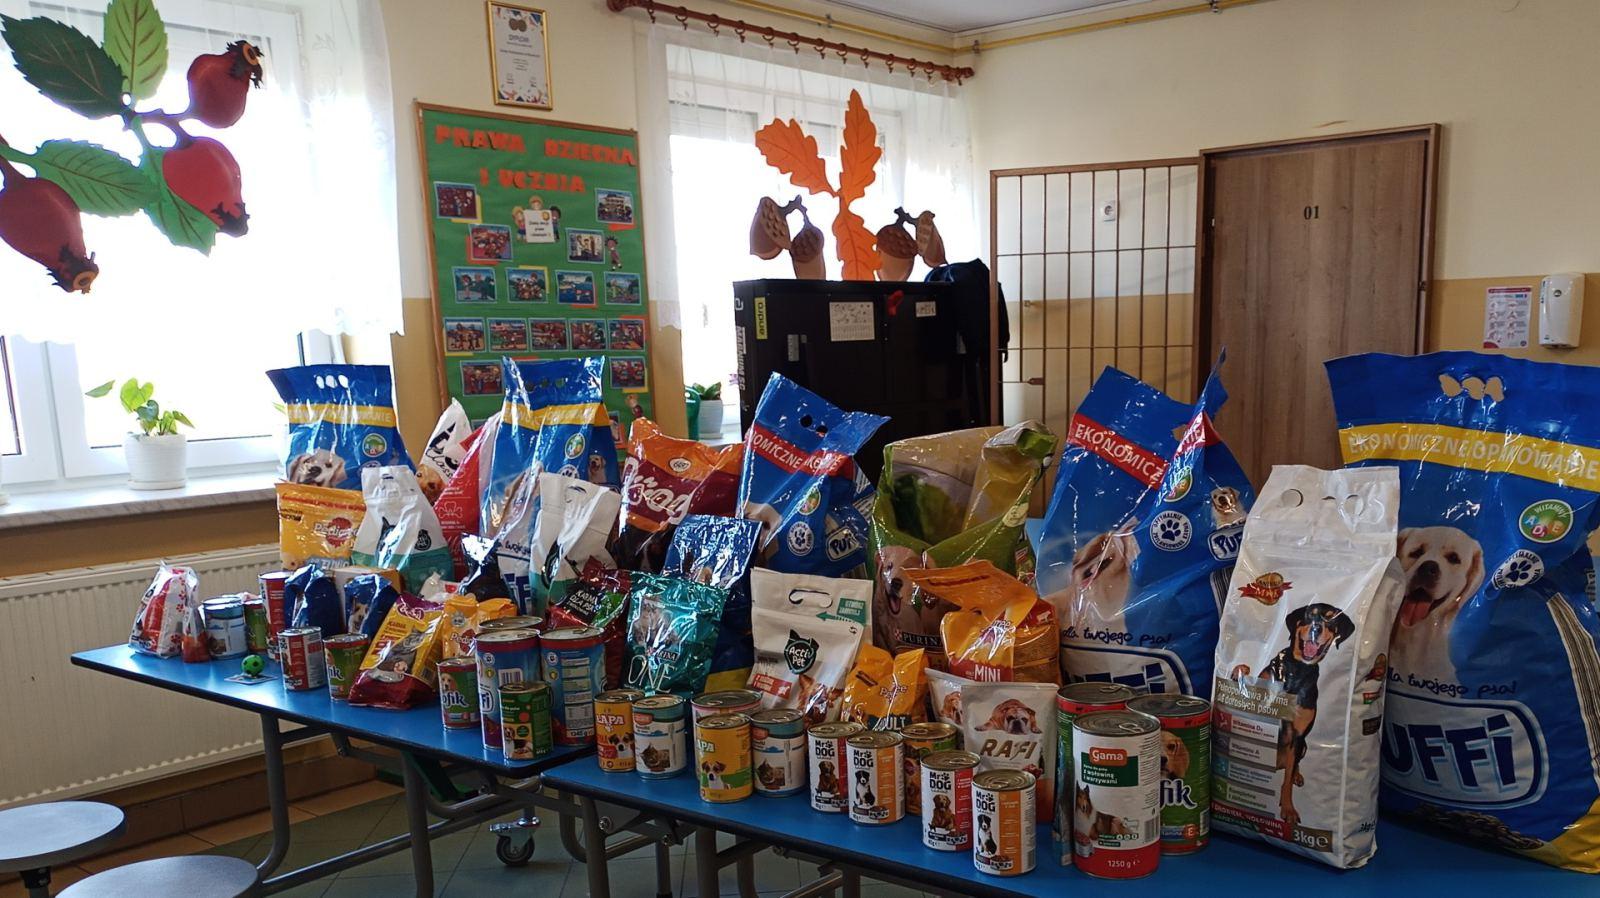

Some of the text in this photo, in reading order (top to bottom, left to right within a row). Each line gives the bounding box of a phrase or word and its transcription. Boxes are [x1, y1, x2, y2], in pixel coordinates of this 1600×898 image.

[435, 125, 637, 166] PRAWA DZIECKA
[499, 169, 586, 194] UCZNIA
[1303, 206, 1320, 220] 01
[757, 302, 765, 336] andro
[1083, 627, 1134, 645] twojego
[792, 656, 806, 668] Pet
[628, 654, 677, 694] ONE
[1408, 673, 1469, 698] twojego
[815, 740, 825, 748] Mr
[980, 738, 1039, 761] RAFI
[815, 748, 835, 757] DOG
[853, 749, 863, 758] Mr
[853, 757, 874, 768] DOG
[929, 771, 940, 780] Mr
[929, 779, 952, 790] DOG
[975, 790, 986, 799] Mr
[975, 799, 996, 812] DOG
[1107, 860, 1126, 868] 1250
